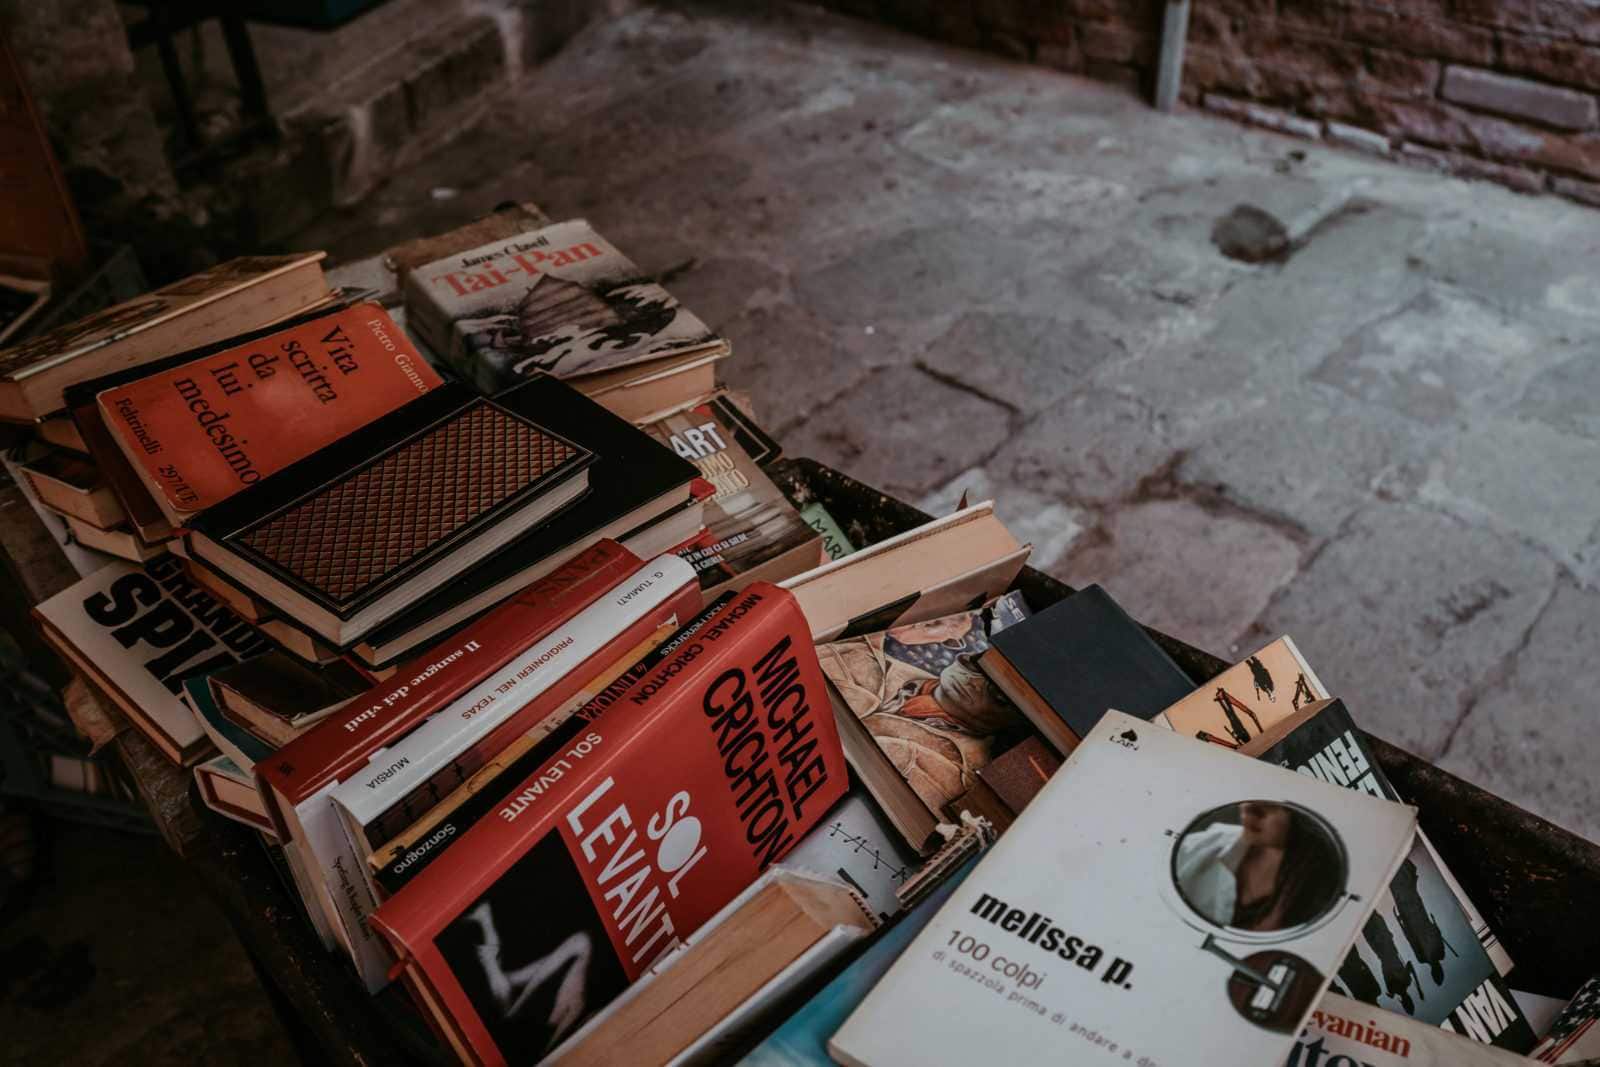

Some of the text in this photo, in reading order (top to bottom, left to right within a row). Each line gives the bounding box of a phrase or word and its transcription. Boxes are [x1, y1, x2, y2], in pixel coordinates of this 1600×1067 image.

[248, 352, 279, 381] da
[281, 340, 338, 406] scritta
[320, 325, 360, 376] Vita
[367, 318, 396, 353] Pietro
[210, 361, 254, 397] lui
[115, 397, 163, 456] Feltrinelli
[174, 377, 261, 485] medesimo
[343, 639, 482, 734] Il sangue dei vinti
[461, 636, 575, 721] PRIGIONIERI NEL TEXAS
[630, 593, 763, 706] MICHAEL CRICHTON
[703, 667, 793, 872] CRICHTON
[752, 635, 828, 820] MICHAEL
[367, 756, 412, 791] MURSIA
[499, 731, 603, 823] SOL LEVANTE
[392, 823, 457, 876] Sonzogno
[646, 790, 708, 899] SOL
[946, 930, 1048, 991] 100 colpi
[969, 893, 1135, 990] melissa p.
[932, 949, 945, 962] di
[949, 959, 1005, 995] spazzola
[1008, 990, 1048, 1017] prima
[1051, 1010, 1067, 1025] di
[1069, 1022, 1119, 1053] andare
